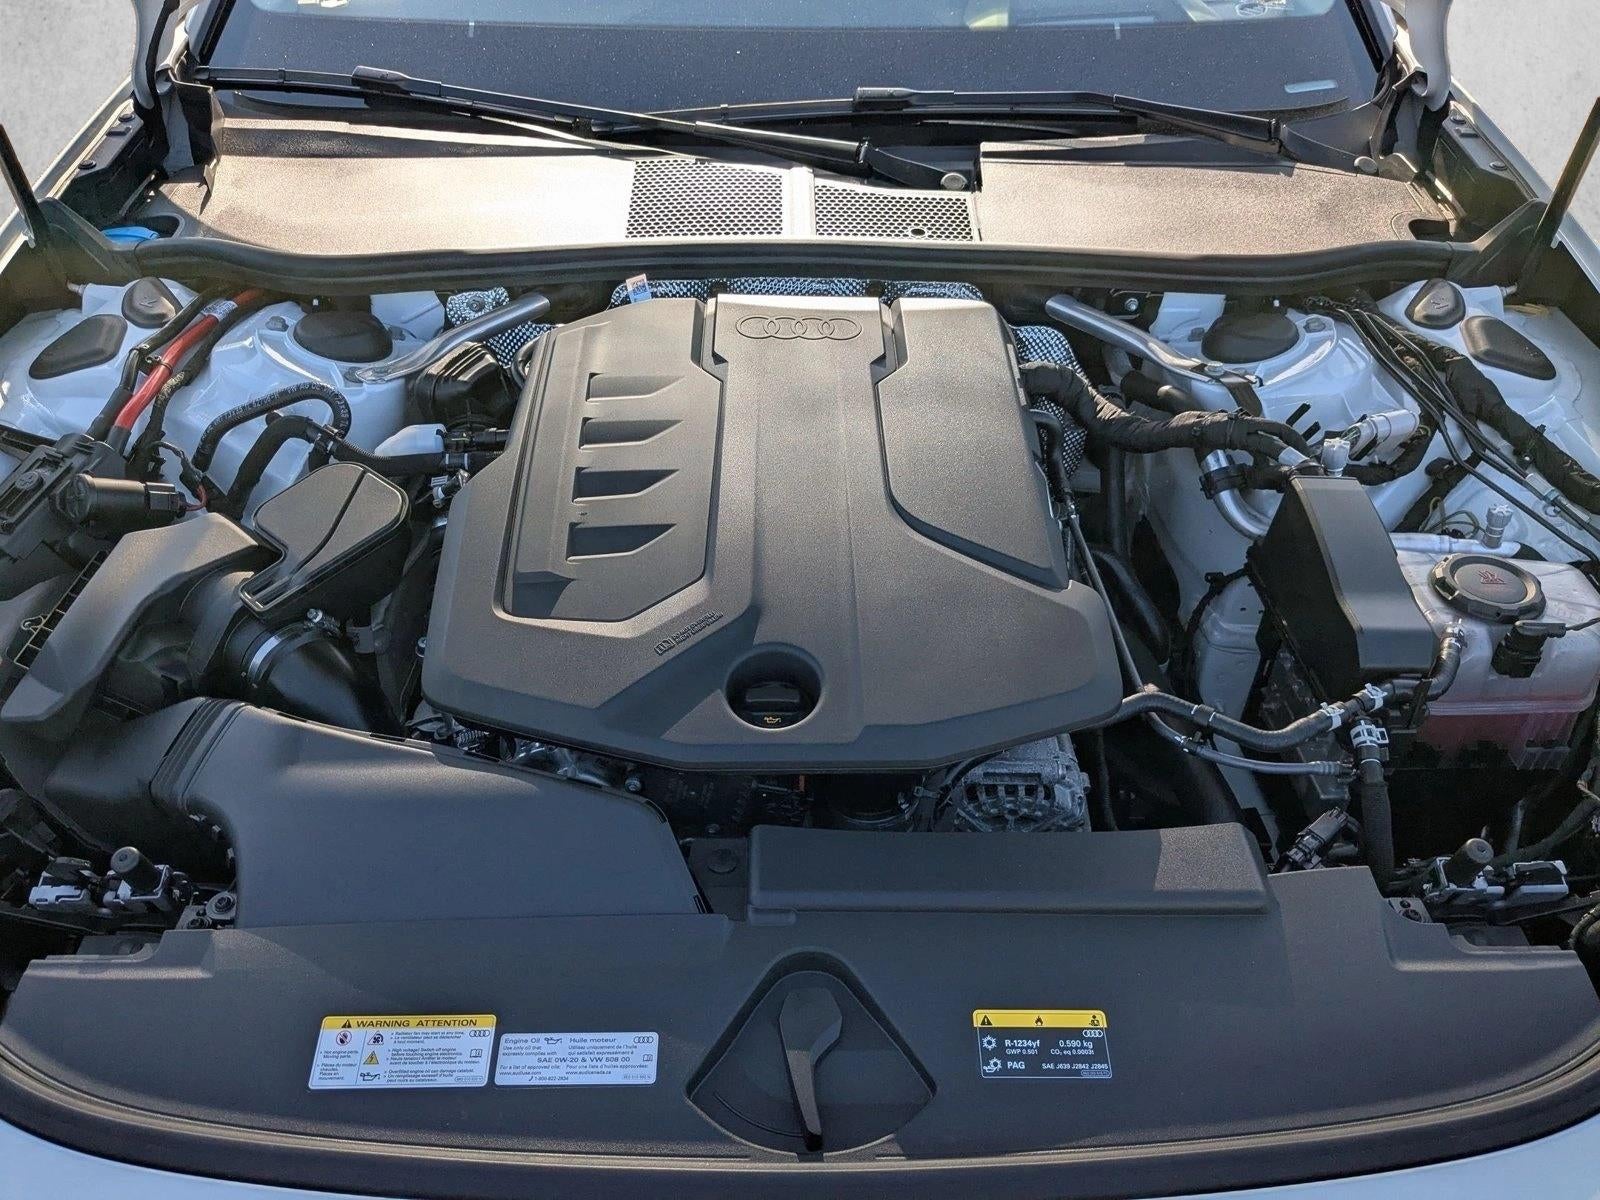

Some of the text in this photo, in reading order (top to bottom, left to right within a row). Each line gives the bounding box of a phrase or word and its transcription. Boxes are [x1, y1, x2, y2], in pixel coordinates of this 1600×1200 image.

[356, 1019, 478, 1028] WARNING ATTENTION
[1005, 1040, 1040, 1048] R-1234yf
[1083, 1040, 1093, 1048] kg
